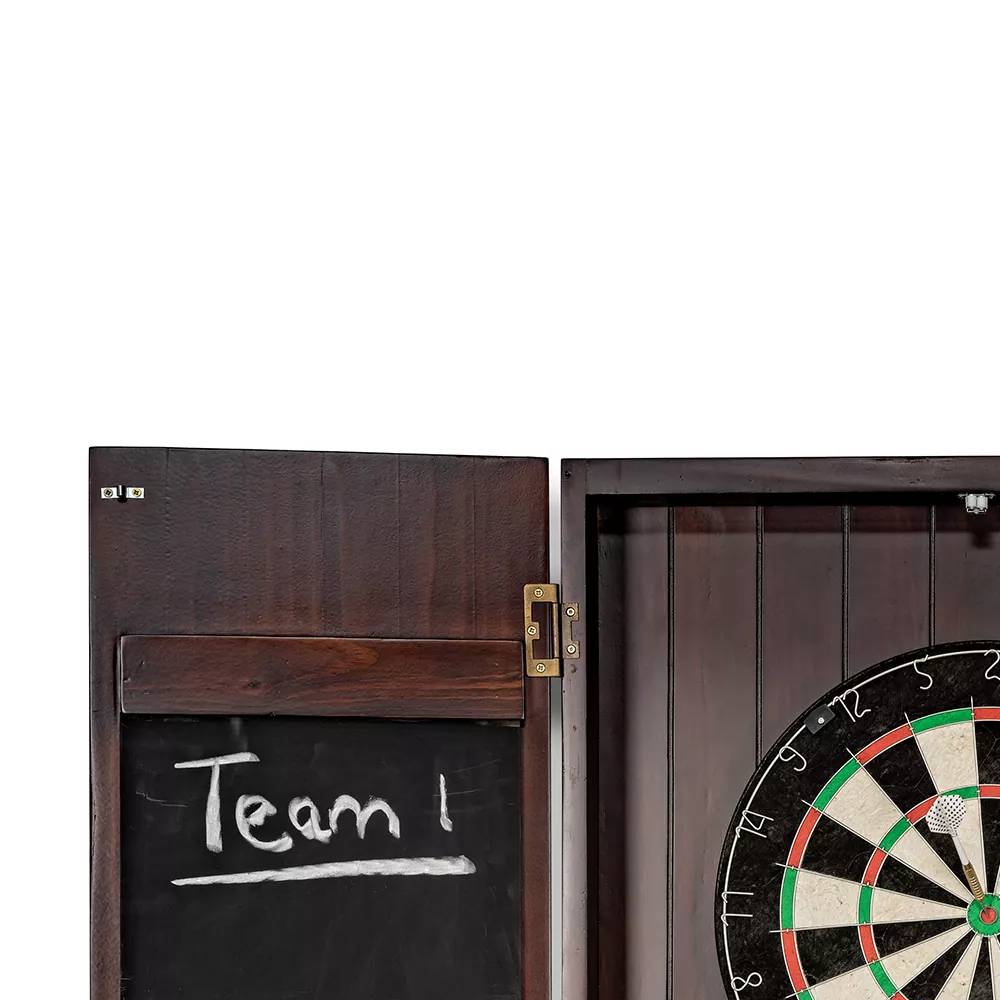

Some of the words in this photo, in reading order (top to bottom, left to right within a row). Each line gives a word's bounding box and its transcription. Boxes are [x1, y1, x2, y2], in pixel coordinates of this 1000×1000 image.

[913, 654, 933, 690] 5
[832, 688, 871, 722] 12
[174, 752, 400, 853] Team
[439, 773, 453, 832] 1
[731, 972, 763, 992] 8
